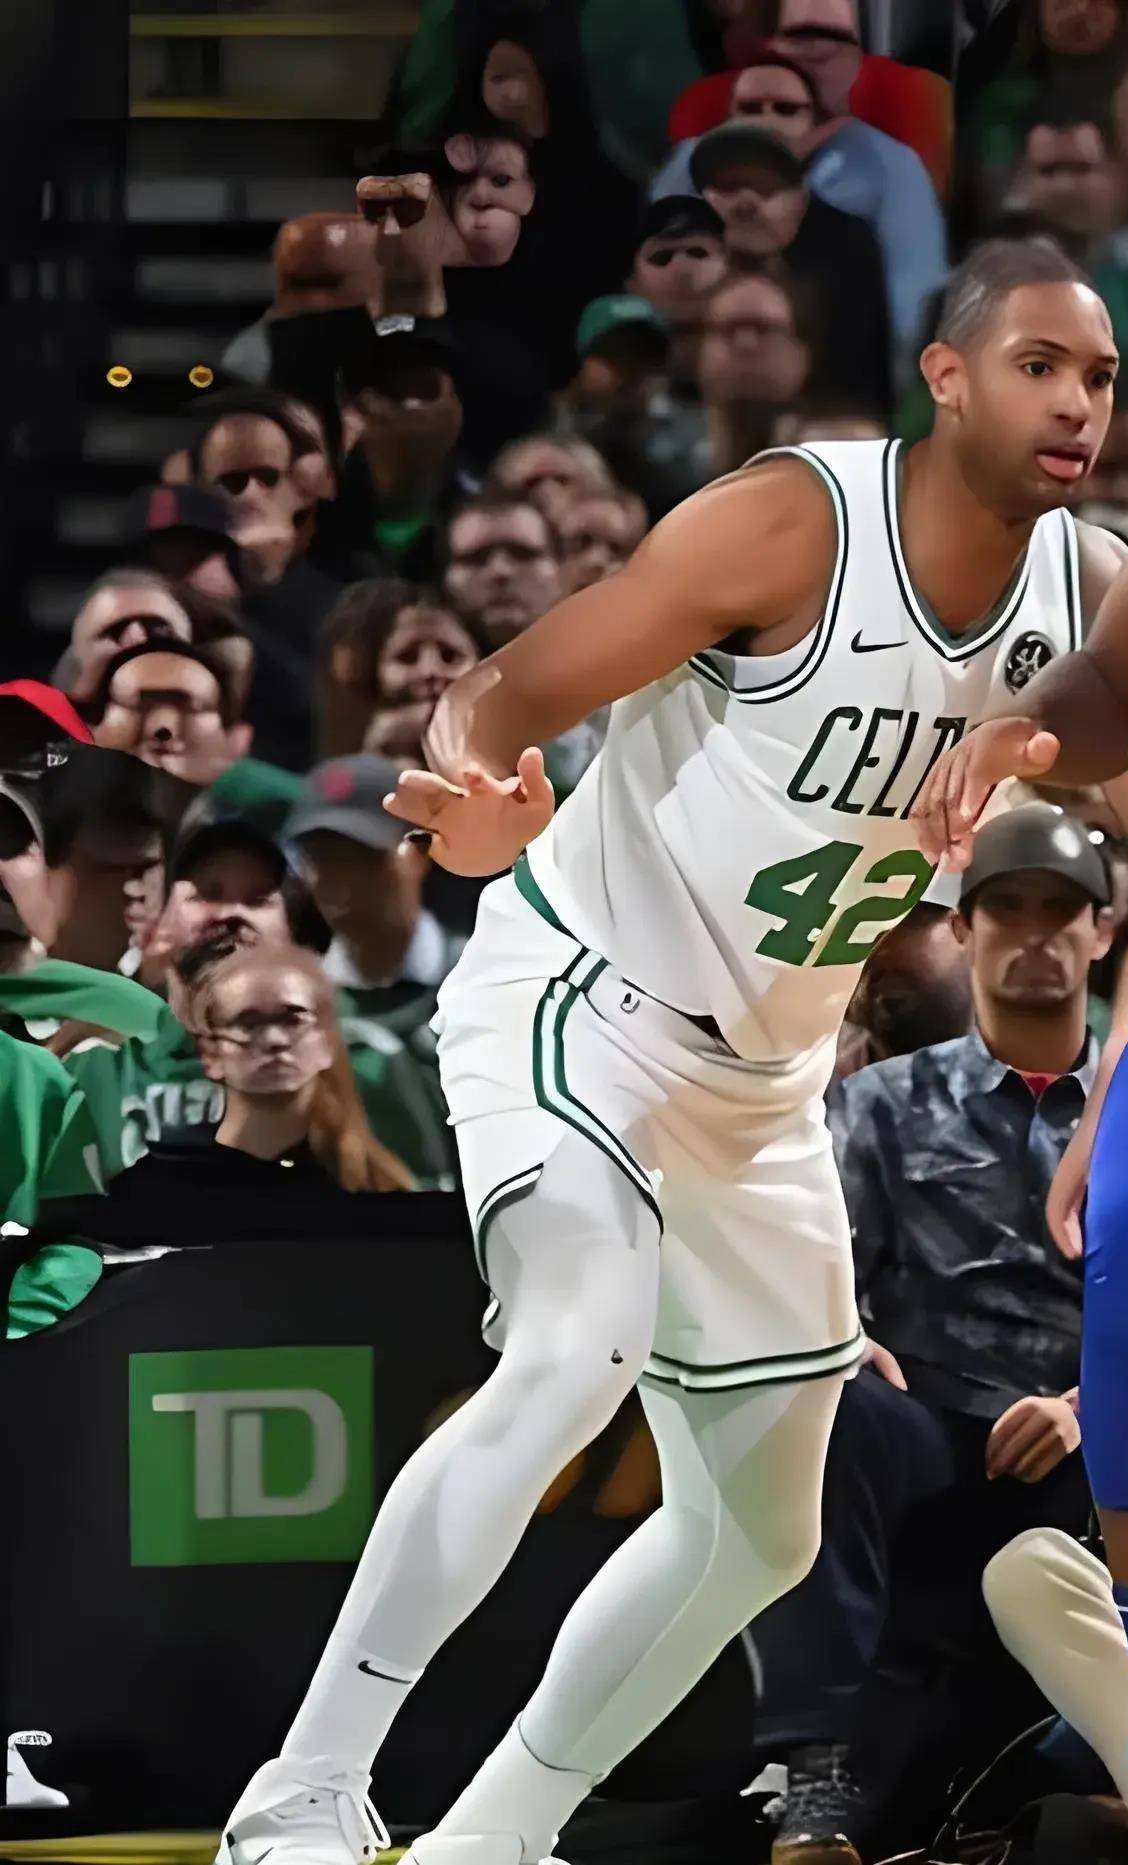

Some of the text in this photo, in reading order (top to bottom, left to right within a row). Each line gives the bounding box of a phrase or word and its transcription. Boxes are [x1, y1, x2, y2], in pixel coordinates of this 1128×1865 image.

[786, 706, 968, 820] CELT
[744, 840, 938, 968] 42
[152, 1387, 348, 1519] TD
